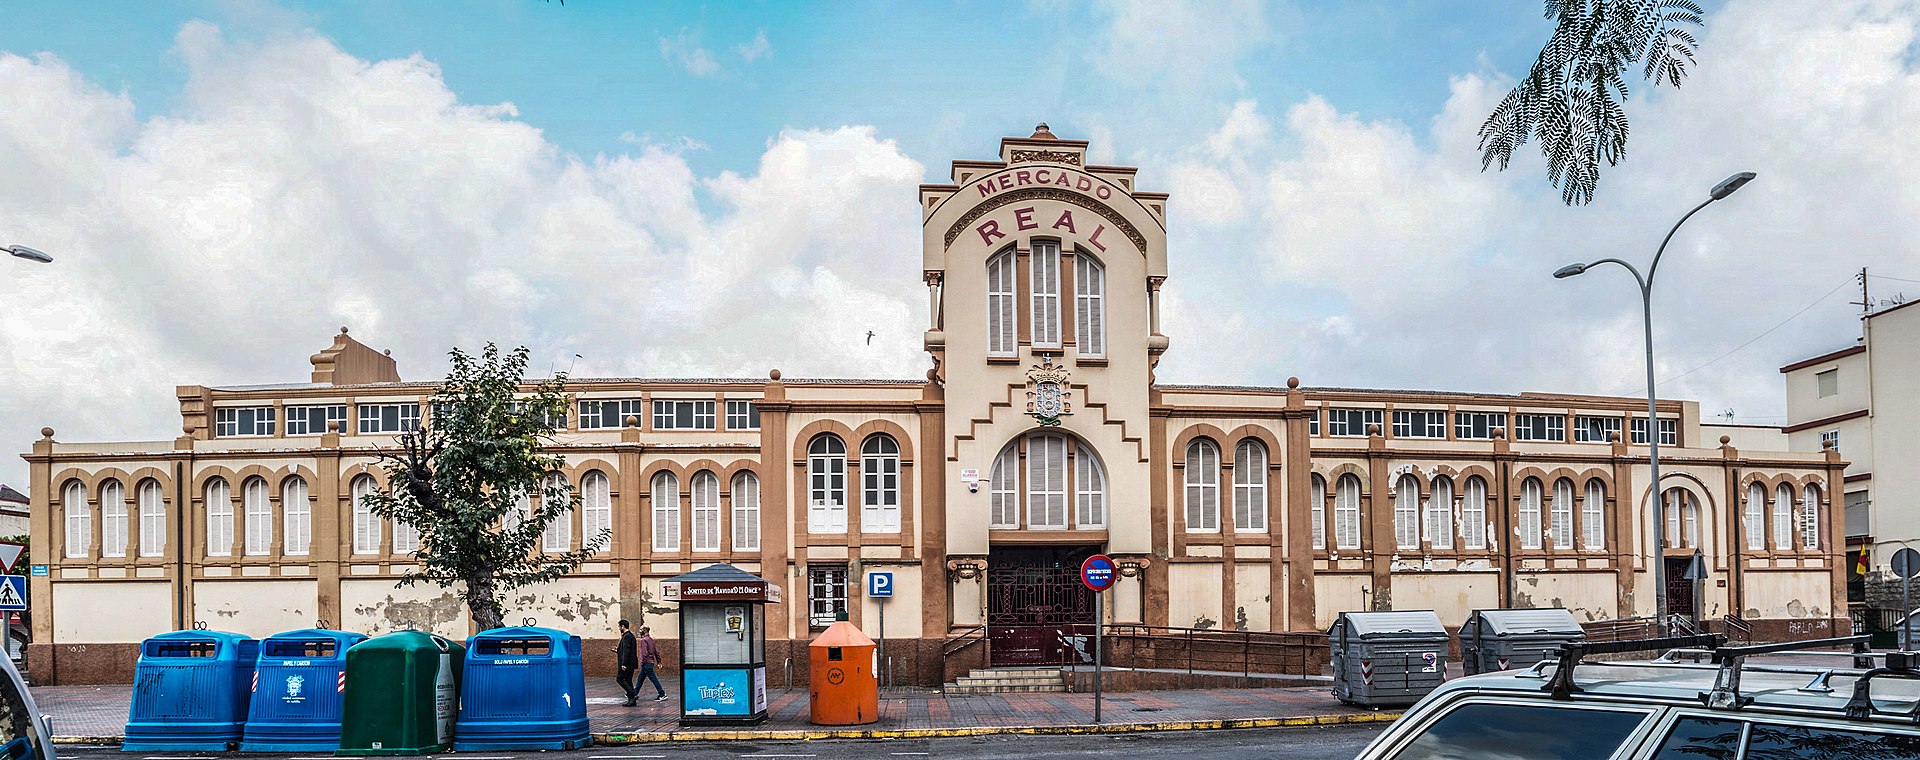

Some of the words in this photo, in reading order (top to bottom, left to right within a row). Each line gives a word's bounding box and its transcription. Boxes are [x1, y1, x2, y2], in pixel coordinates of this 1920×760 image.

[976, 169, 1112, 201] MERCADO
[976, 206, 1107, 253] REAL
[873, 574, 888, 594] P
